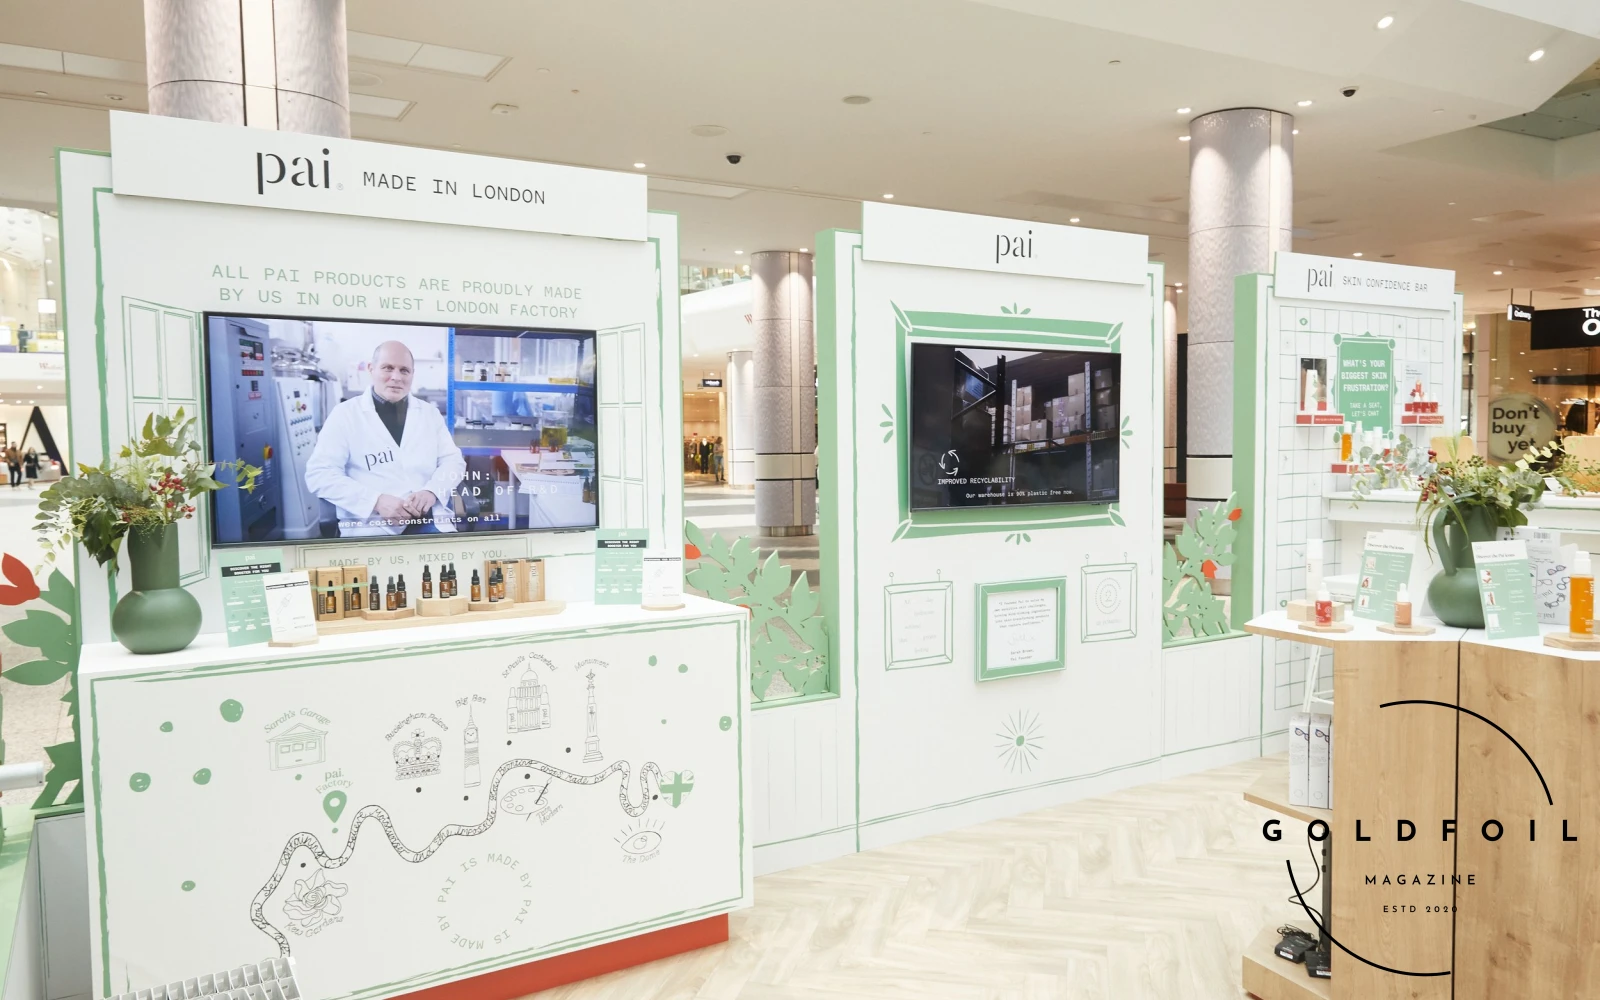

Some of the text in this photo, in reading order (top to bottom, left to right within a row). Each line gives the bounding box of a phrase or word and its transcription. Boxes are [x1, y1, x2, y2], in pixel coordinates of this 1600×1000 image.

[256, 148, 330, 194] pai
[363, 171, 546, 205] MADE IN LONDON
[996, 230, 1032, 264] pai
[212, 264, 582, 300] ALL PAI PRODUCTS ARE PROUDLY MADE
[1307, 264, 1333, 292] pai
[1342, 276, 1428, 292] SKIN CONFIDENCE BAR
[219, 288, 578, 319] BY US IN OUR WEST LONDON FACTORY
[1582, 308, 1600, 318] Th
[1342, 359, 1366, 368] WHAT'S
[1341, 372, 1368, 380] BIGGEST
[1343, 384, 1389, 392] FRUSTRATION?
[1493, 406, 1540, 419] Don't
[1492, 422, 1525, 437] buy
[364, 447, 394, 471] pai
[438, 484, 558, 497] HEAD OF R&D
[338, 520, 362, 528] were
[369, 518, 393, 526] cost
[399, 514, 462, 525] constraints
[484, 514, 500, 522] all
[329, 550, 506, 566] MADE BY US, MIXED BY YOU.
[574, 658, 610, 671] Monument
[455, 694, 487, 708] Big Ben
[264, 707, 331, 734] Sarah's Garage
[385, 712, 427, 741] Buckingham
[316, 779, 354, 794] Factory
[437, 853, 532, 950] PAI IS MADE BY PAI IS MADE BY
[284, 916, 344, 937] Kew Gardens
